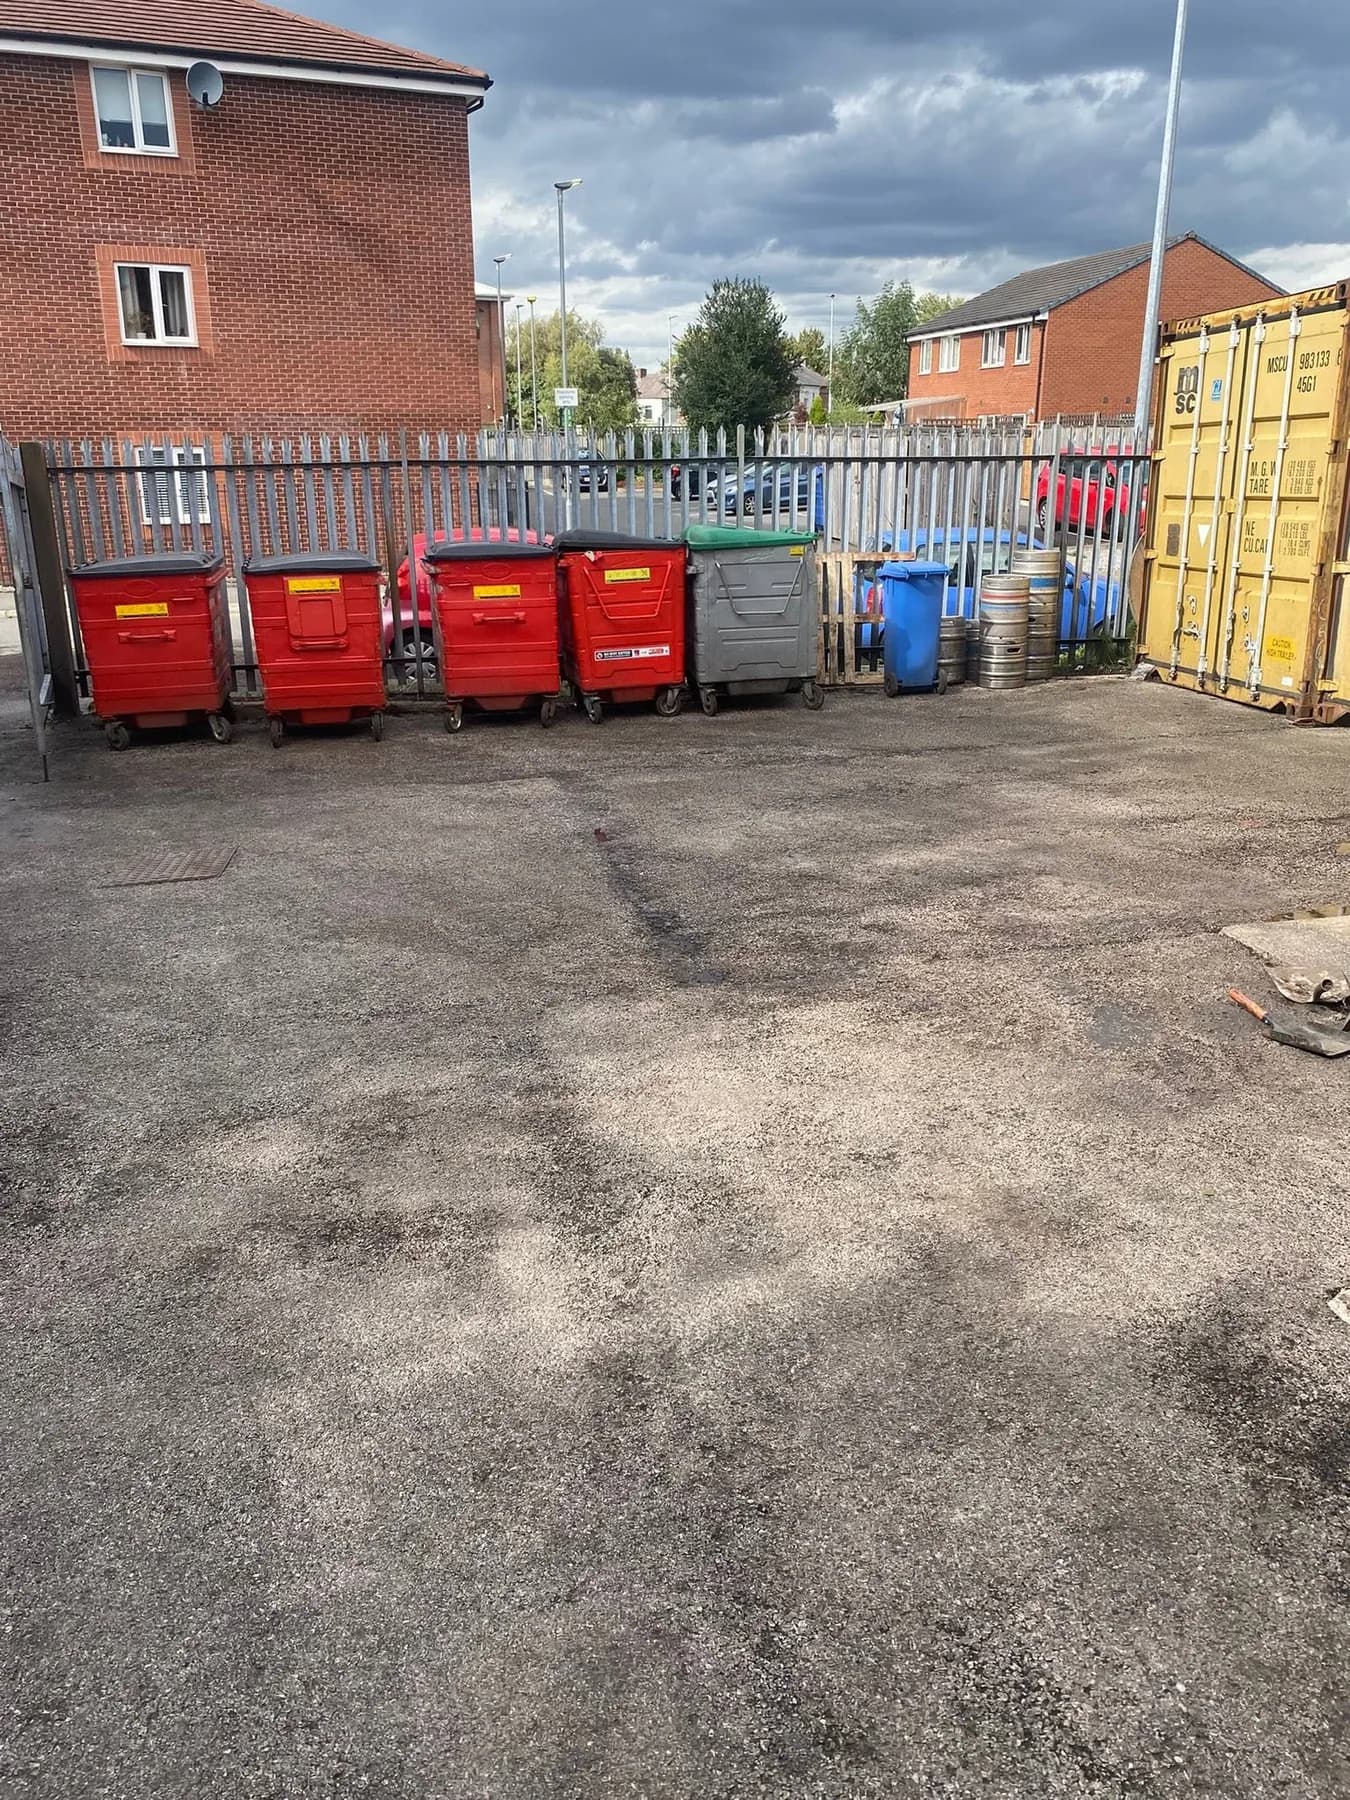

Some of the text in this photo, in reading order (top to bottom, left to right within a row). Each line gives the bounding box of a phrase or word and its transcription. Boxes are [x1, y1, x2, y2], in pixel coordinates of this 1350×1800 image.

[1267, 355, 1288, 374] MSCU
[1299, 350, 1331, 370] 983133
[1297, 375, 1317, 393] 45G1
[1249, 479, 1269, 494] TARE
